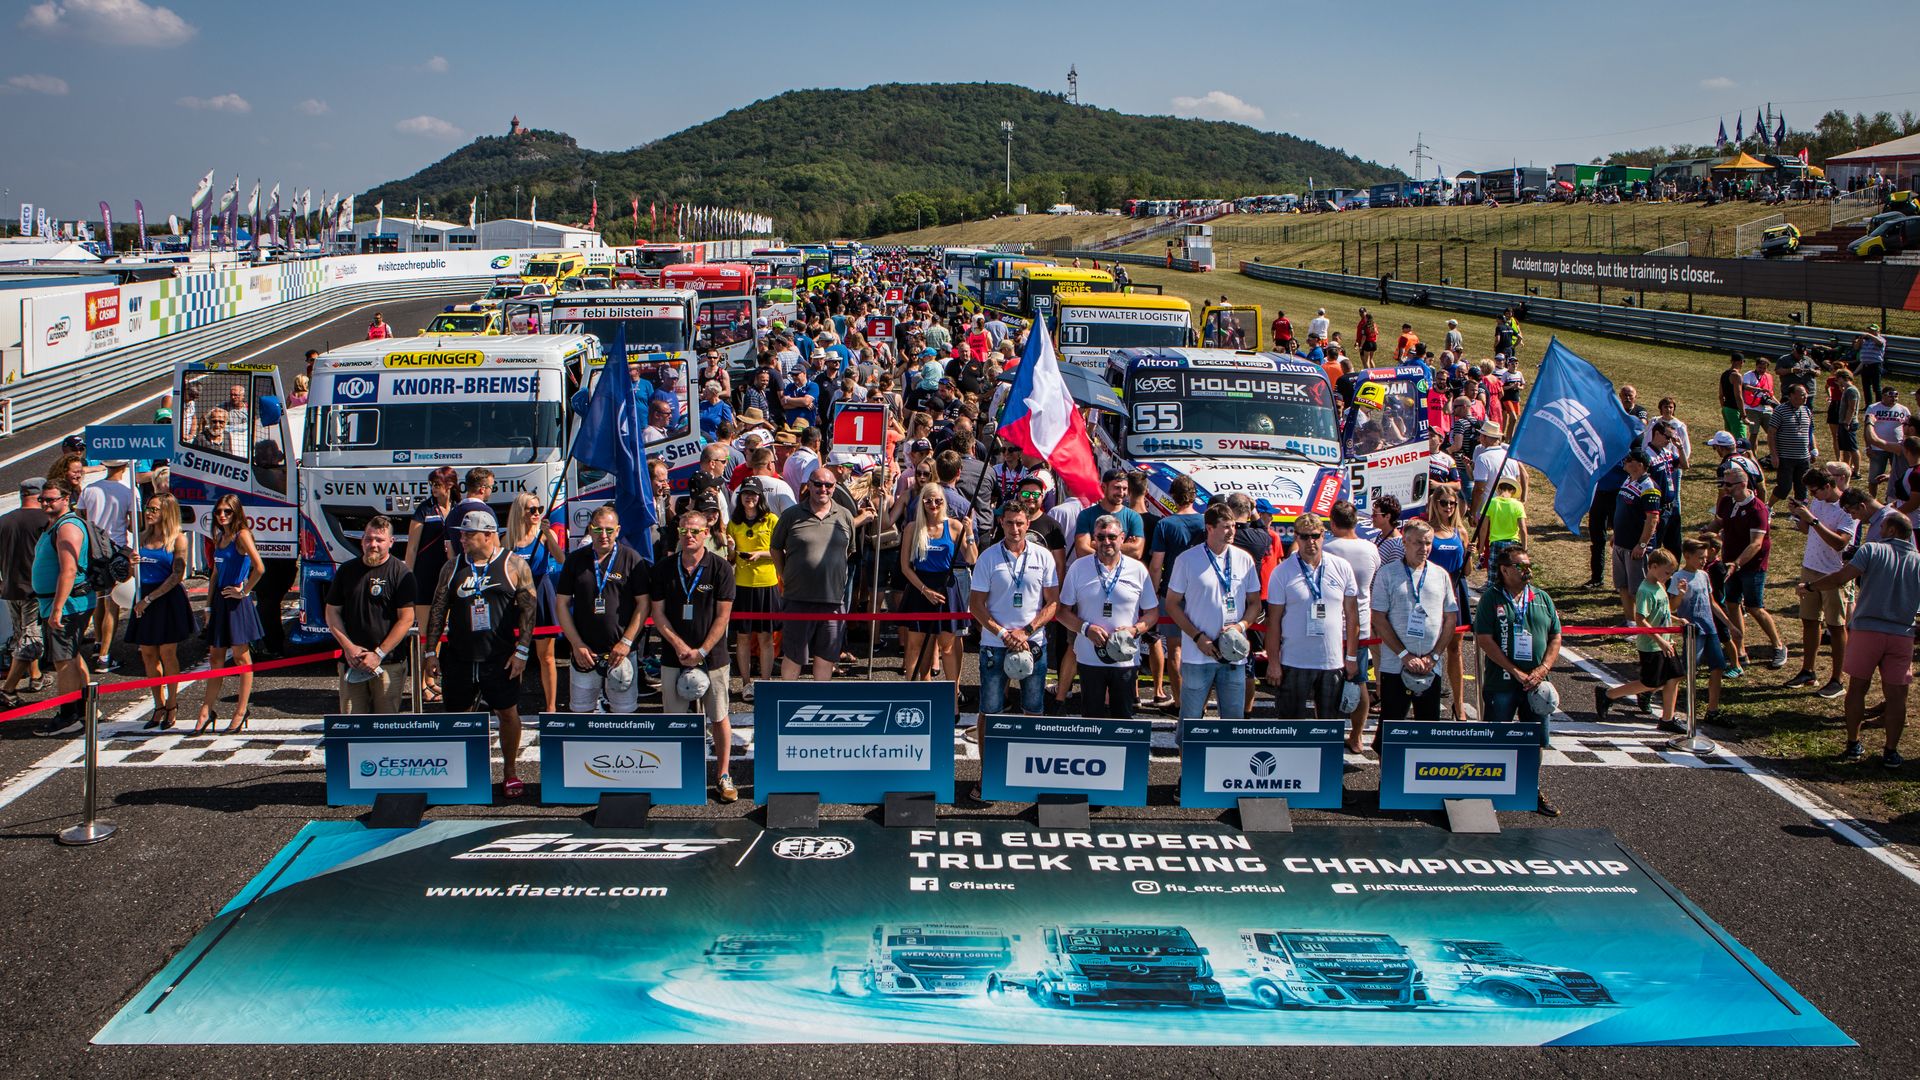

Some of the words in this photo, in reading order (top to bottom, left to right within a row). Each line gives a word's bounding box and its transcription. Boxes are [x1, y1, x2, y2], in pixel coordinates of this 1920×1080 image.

[377, 258, 446, 272] #visitczechrepublic
[1512, 256, 1542, 272] Accident
[1543, 261, 1559, 276] may
[1560, 260, 1570, 274] be
[1571, 261, 1595, 277] close,
[1597, 262, 1612, 277] but
[1613, 263, 1629, 279] the
[1630, 264, 1668, 283] training
[1670, 266, 1679, 281] is
[1681, 267, 1724, 284] closer...
[891, 290, 899, 300] 3
[1052, 286, 1092, 294] HEROES
[1035, 296, 1050, 306] 30
[583, 307, 606, 318] febi
[609, 307, 654, 318] bilstein
[1070, 309, 1098, 319] SVEN
[1098, 310, 1138, 320] WALTER
[1139, 312, 1184, 322] LOGISTIK
[875, 322, 886, 336] 2
[1067, 326, 1082, 343] 11
[390, 352, 477, 366] PALFINGER
[1137, 358, 1179, 368] Altron
[1280, 363, 1318, 374] Altron
[392, 376, 541, 396] KNORR-BREMSE
[1190, 377, 1309, 397] HOLOUBEK
[1267, 395, 1311, 403] KONGERN
[1356, 397, 1378, 407] TOTAL
[1137, 404, 1179, 431] 55
[1875, 410, 1893, 418] JUST
[853, 415, 864, 442] 1
[92, 436, 125, 450] GRID
[128, 435, 167, 449] WALK
[1161, 438, 1204, 450] ELDIS
[1218, 438, 1270, 450] SYNER
[1303, 443, 1338, 458] ELDIS
[1380, 451, 1418, 469] SYNER
[324, 481, 366, 496] SVEN
[372, 480, 431, 495] WALTE
[1213, 481, 1243, 493] job
[1246, 480, 1270, 491] air
[1250, 491, 1294, 500] technic
[1316, 478, 1338, 513] NUTREND
[245, 516, 293, 532] OSCH
[372, 720, 441, 730] #onetruckfamily
[587, 721, 656, 731] #onetruckfamily
[1034, 723, 1103, 735] #onetruckfamily
[1231, 726, 1298, 737] #onetruckfamily
[1430, 728, 1495, 738] #onetruckfamily
[785, 744, 924, 762] #onetruckfamily
[378, 757, 448, 768] ČESMAD
[592, 754, 659, 769] S.W.L.
[1025, 757, 1107, 776] IVECO
[379, 767, 449, 777] BOHEMIA
[1418, 765, 1503, 777] GOODYEAR
[1222, 778, 1302, 790] GRAMMER
[910, 830, 983, 847] FIA
[1001, 831, 1252, 851] EUROPEAN
[778, 840, 848, 856] FIA
[909, 852, 1072, 871] TRUCK
[1088, 854, 1268, 873] RACING
[1282, 857, 1630, 876] CHAMPIONSHIP
[425, 883, 668, 897] www.fiaetrc.com
[949, 880, 1016, 891] @fiaetrc
[1165, 883, 1285, 894] fia_etrc_official
[1363, 883, 1638, 895] FIAETRCEuropeanTruckRacingChampionship
[1301, 943, 1325, 952] 44
